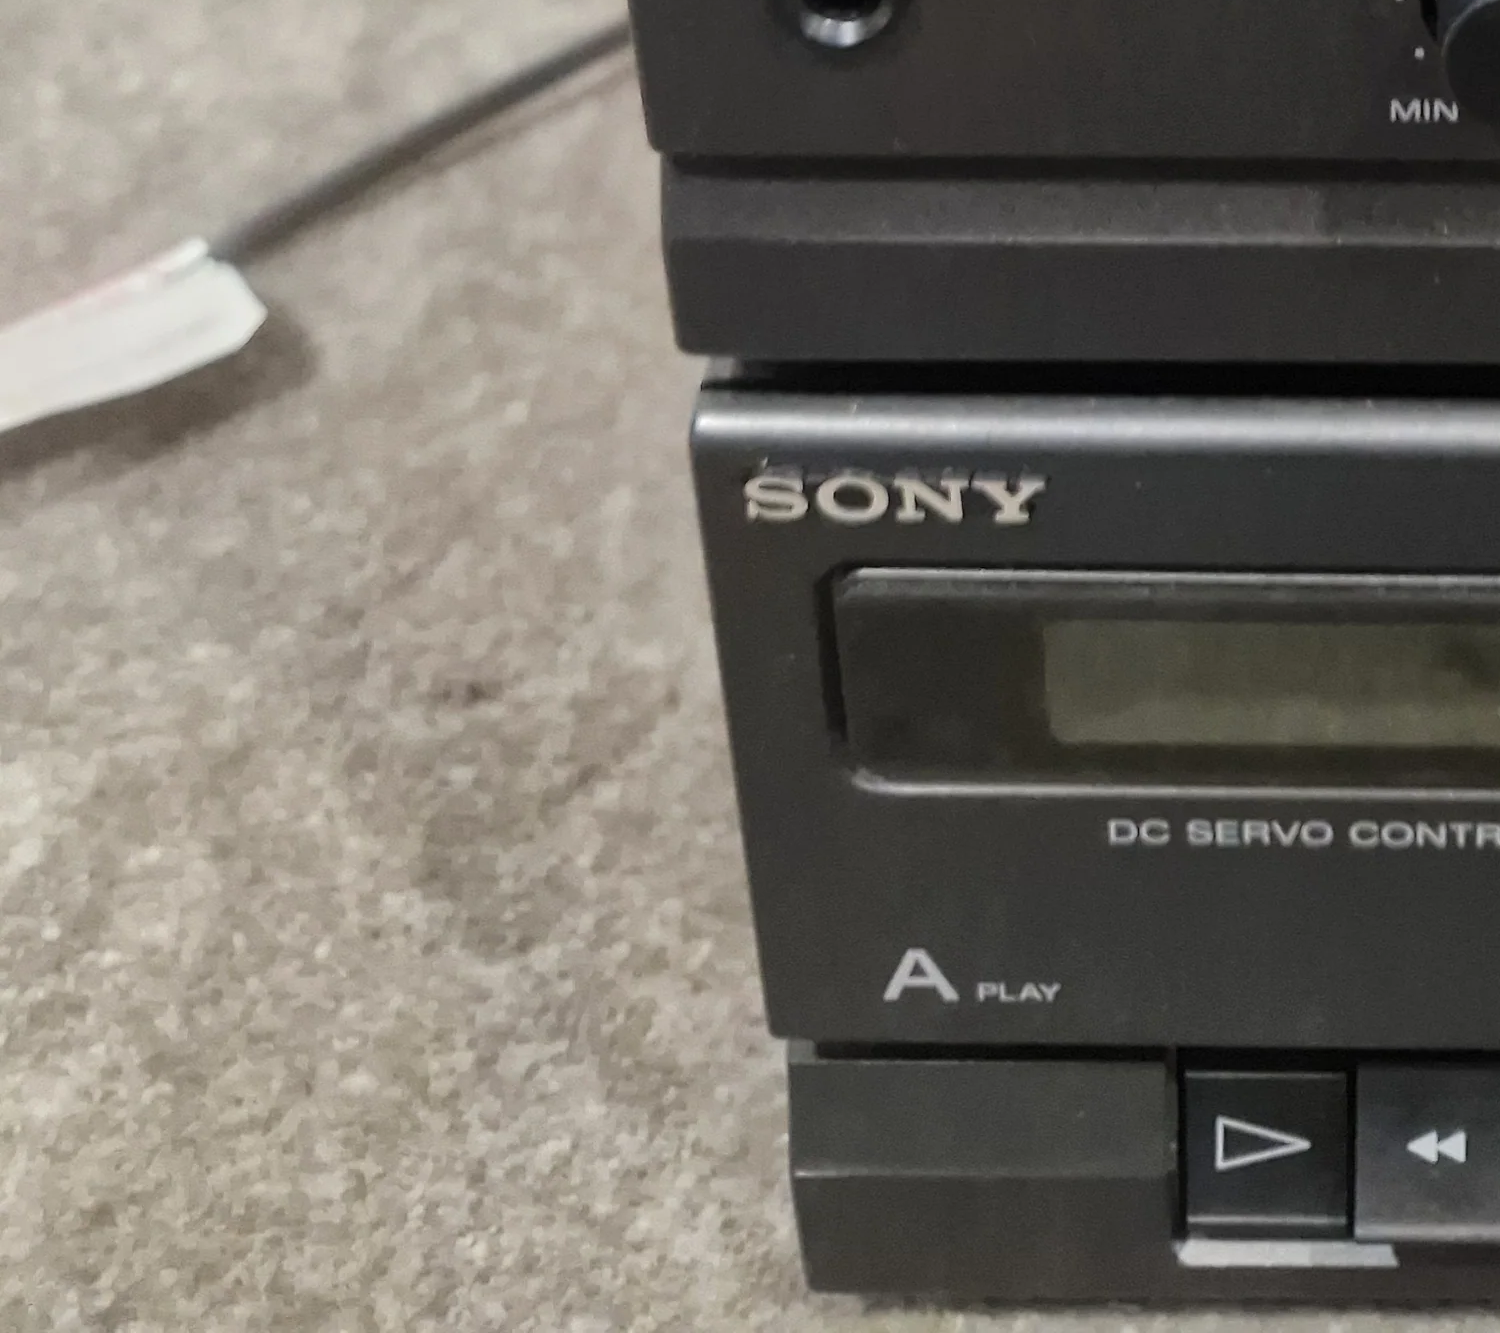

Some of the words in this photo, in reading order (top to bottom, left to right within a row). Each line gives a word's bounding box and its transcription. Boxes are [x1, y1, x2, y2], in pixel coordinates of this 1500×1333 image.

[1389, 98, 1460, 123] MIN
[742, 473, 1046, 523] SONY
[1107, 819, 1171, 847] DC
[1186, 820, 1334, 848] SERVO
[882, 948, 959, 1002] A
[977, 982, 1061, 1003] PLAY
